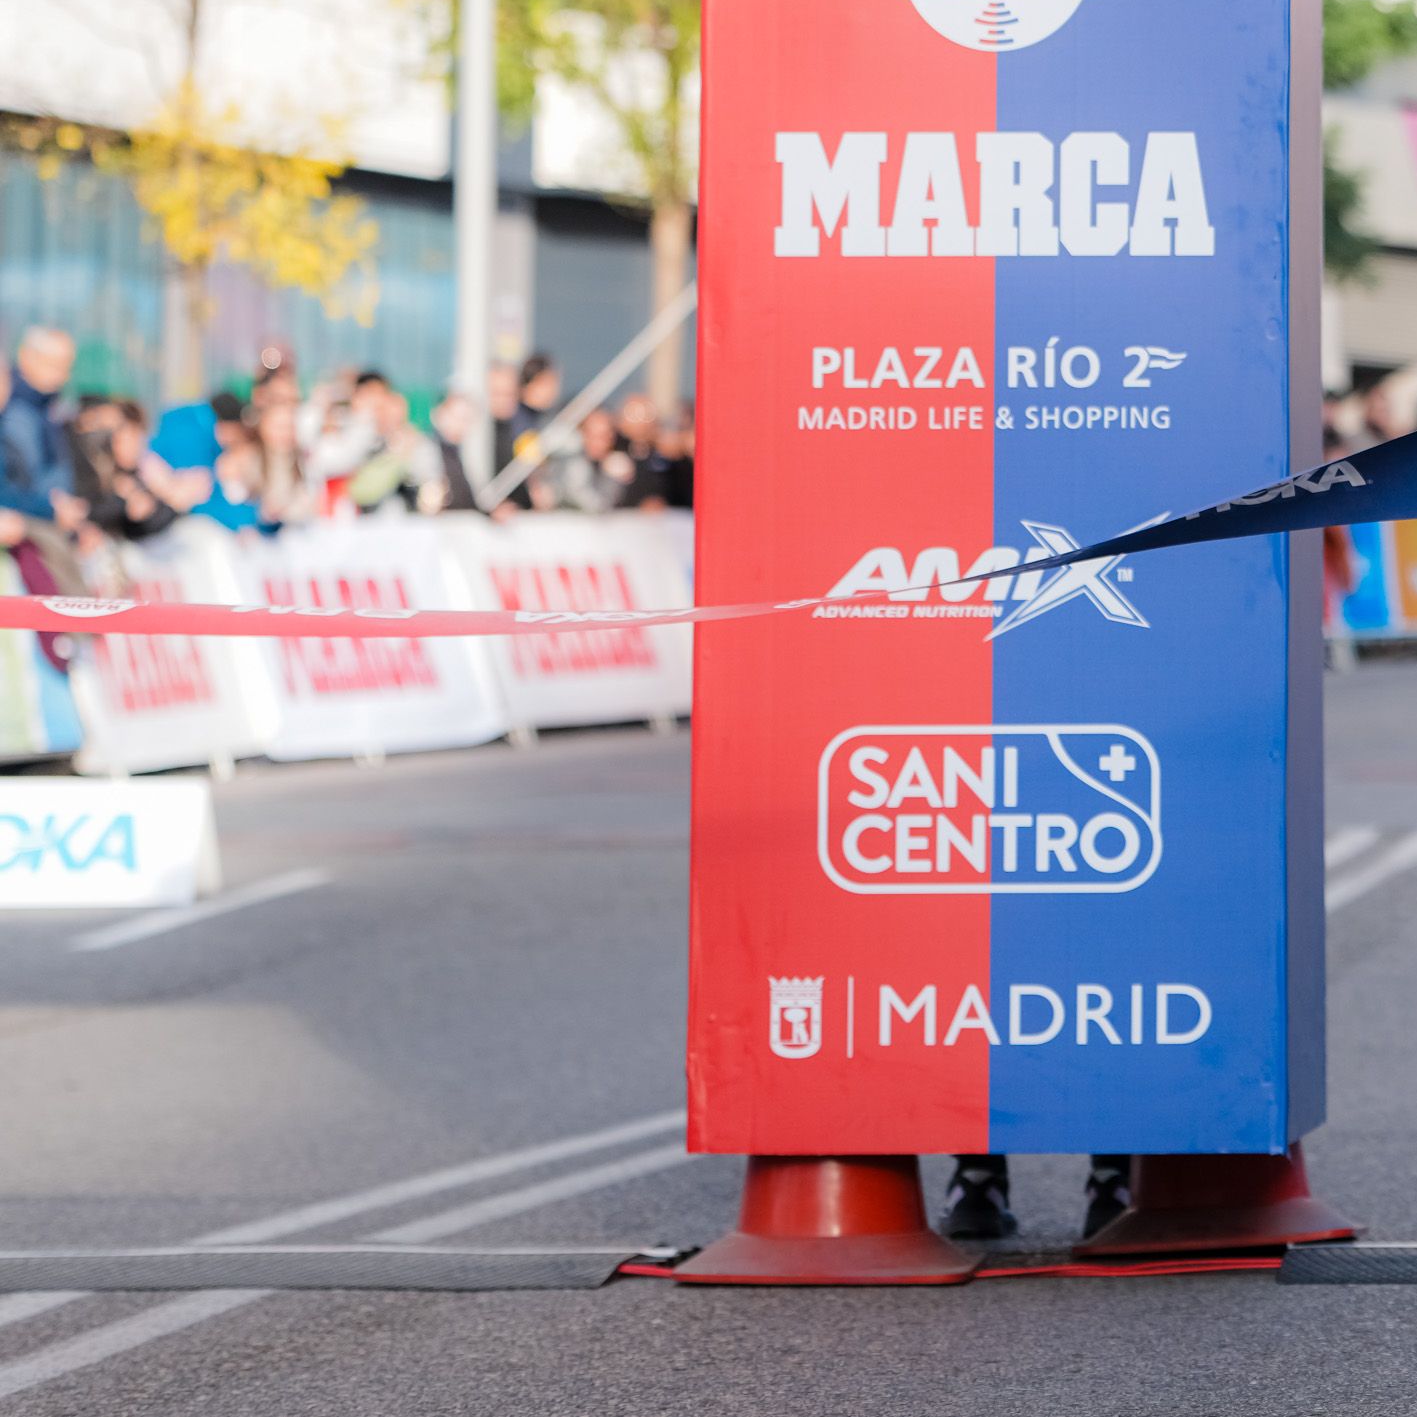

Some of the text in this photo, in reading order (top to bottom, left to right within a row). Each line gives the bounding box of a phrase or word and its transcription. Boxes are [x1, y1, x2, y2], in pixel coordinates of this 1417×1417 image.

[775, 132, 1214, 256] MARCA
[813, 347, 984, 388] PLAZA
[1008, 337, 1100, 388] RÍO
[799, 406, 1170, 429] MADRID LIFE & SHOPPING
[812, 605, 1003, 618] ADVANCED NUTRITION
[848, 747, 1017, 808] SANI
[842, 813, 1141, 873] CENTRO
[879, 984, 1211, 1046] MADRID
